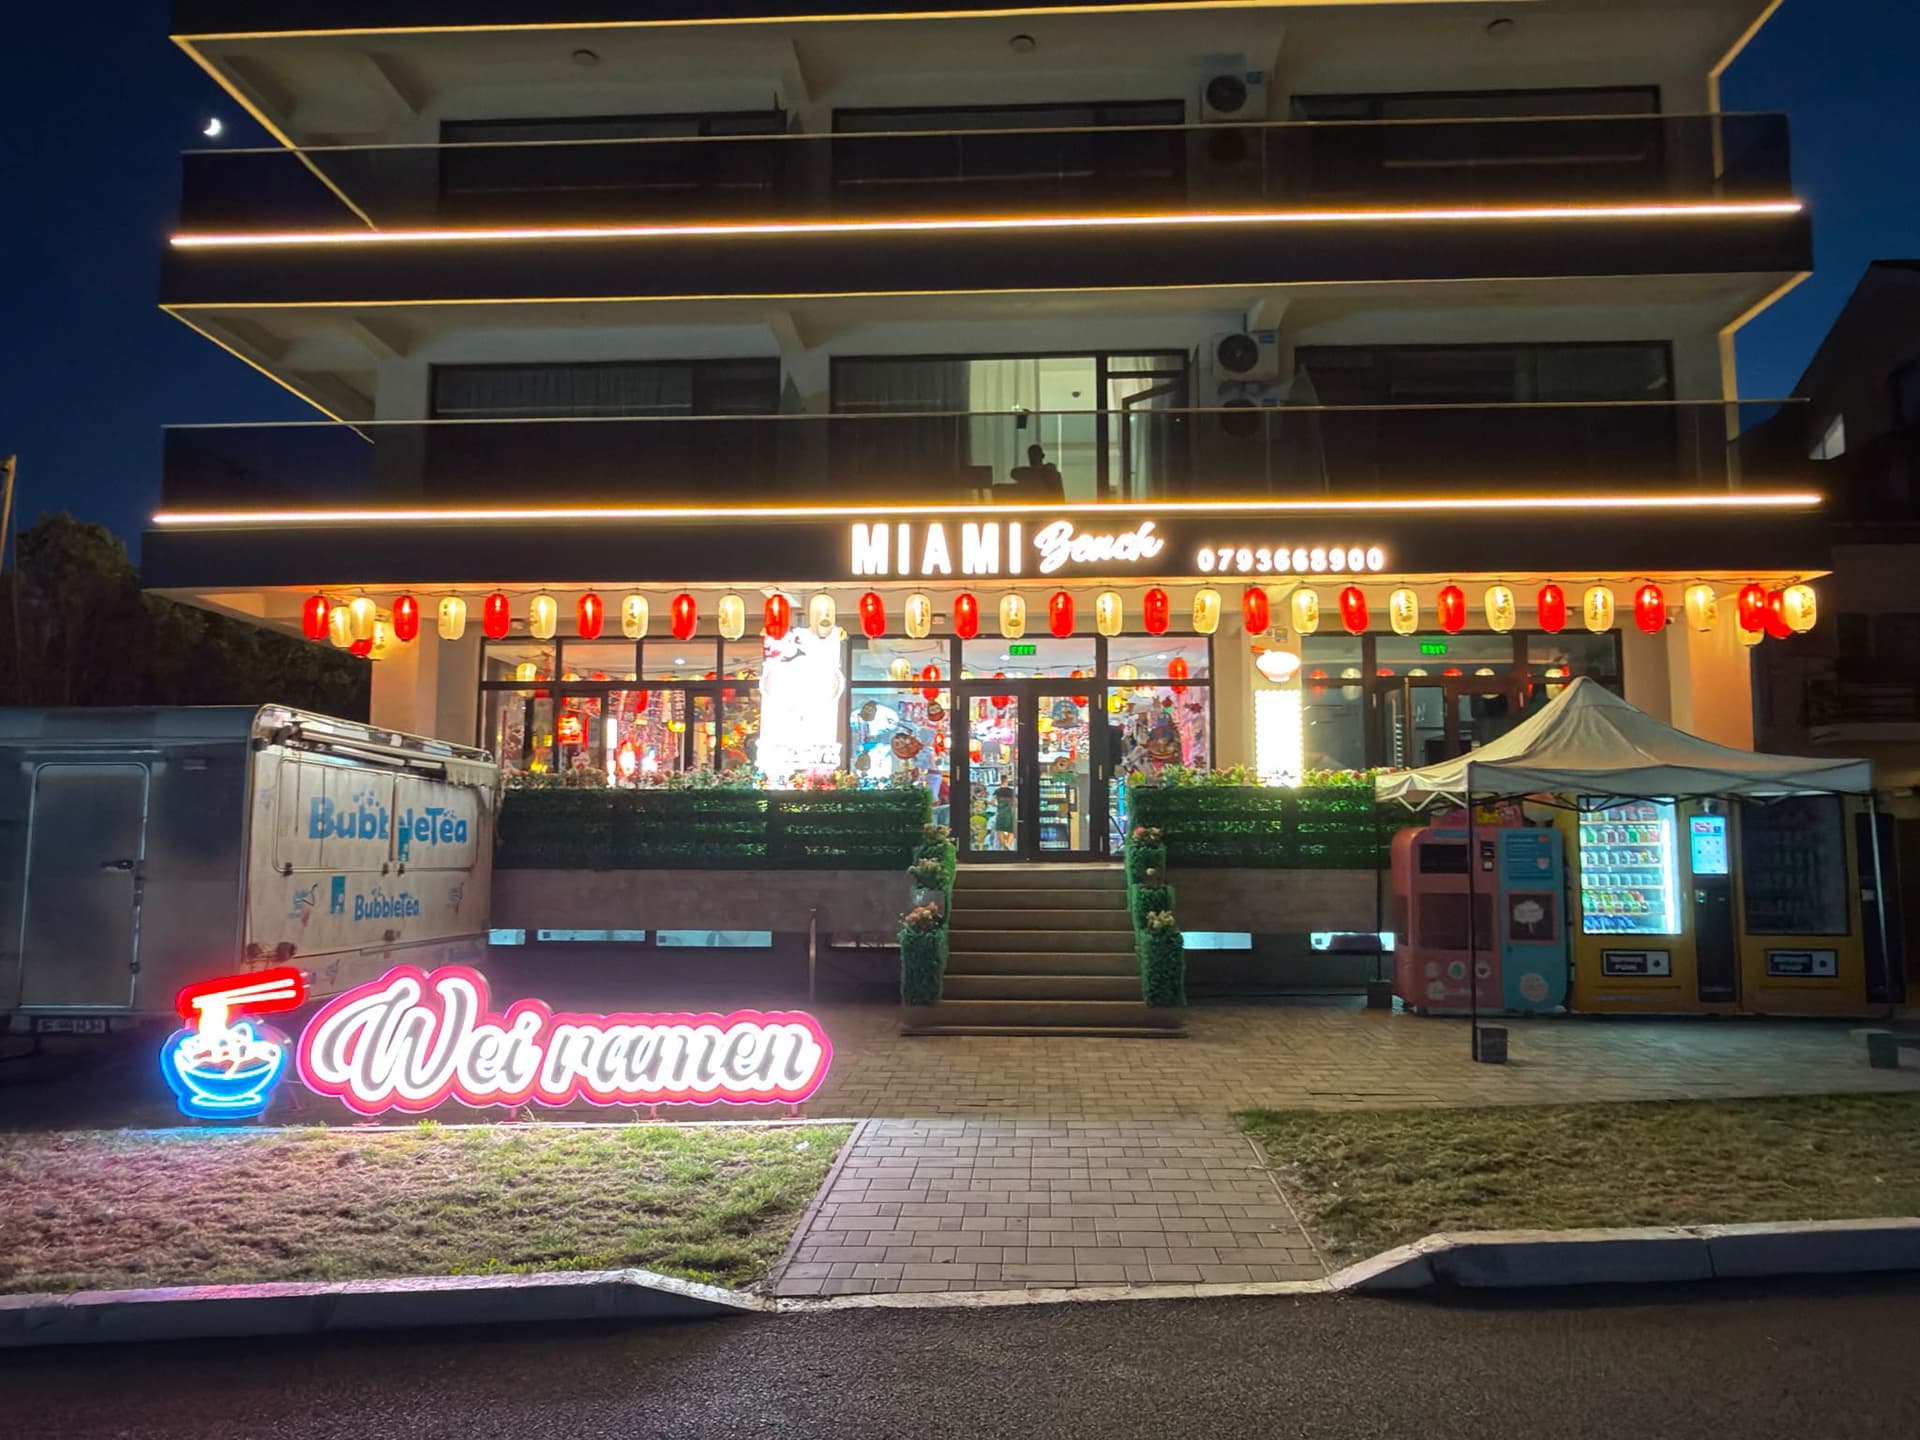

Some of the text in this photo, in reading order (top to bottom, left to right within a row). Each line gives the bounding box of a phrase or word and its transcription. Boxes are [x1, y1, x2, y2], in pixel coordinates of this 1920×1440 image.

[851, 520, 1164, 575] MIAMI Beach
[1197, 547, 1384, 572] 0793668900
[1010, 645, 1035, 655] EXIT
[1421, 643, 1447, 655] EXIT
[354, 892, 420, 921] BubbleTea
[315, 977, 820, 1100] Wei ramen
